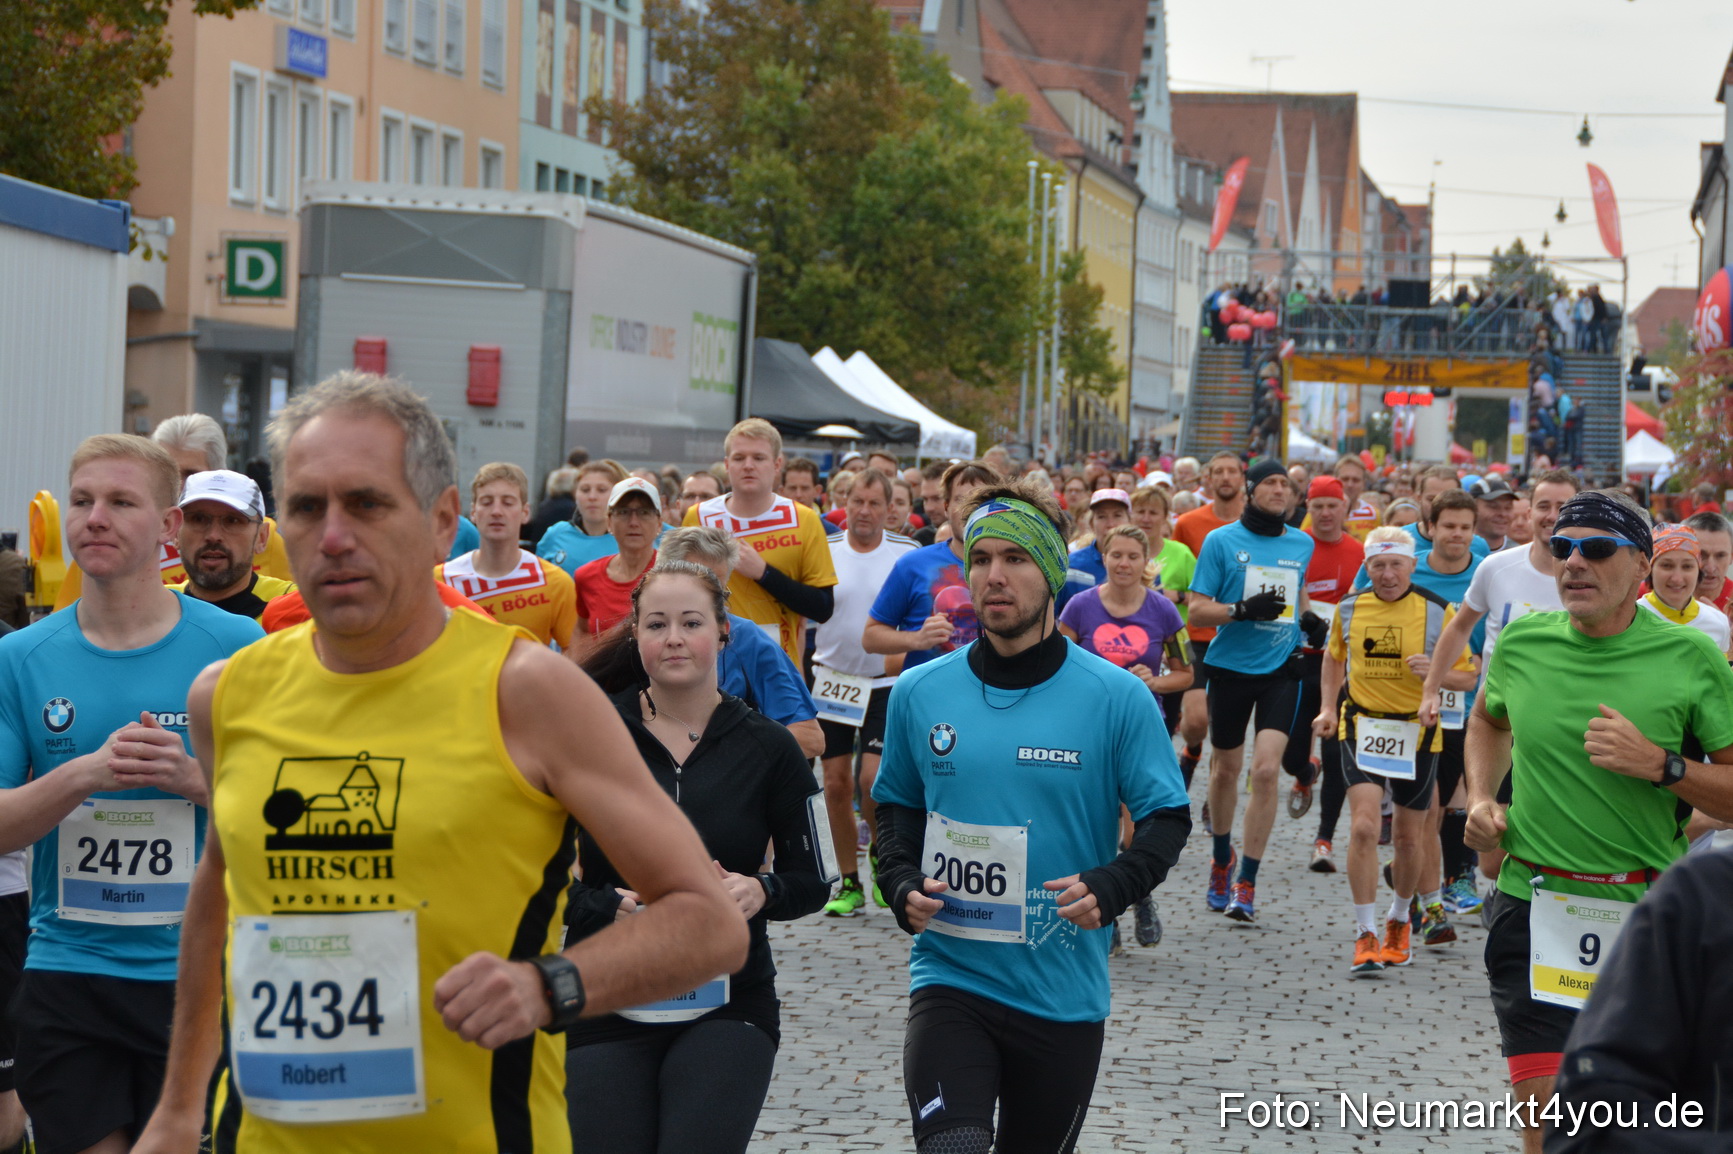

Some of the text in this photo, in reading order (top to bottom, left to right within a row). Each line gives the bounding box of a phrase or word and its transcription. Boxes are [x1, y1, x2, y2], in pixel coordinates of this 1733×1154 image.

[235, 246, 277, 291] D
[616, 318, 648, 355] INDUSTRY
[1383, 361, 1436, 382] ZIEL
[753, 534, 802, 552] BÖGL
[985, 526, 1029, 546] firmenlauf
[1028, 546, 1052, 579] neumarkt
[502, 592, 550, 613] BÖGL
[1100, 645, 1140, 656] adidas
[1364, 659, 1402, 669] HIRSCH
[821, 681, 861, 703] 2472
[45, 737, 76, 748] PARTL
[46, 747, 76, 755] Neumarkt
[1363, 735, 1405, 756] 2921
[932, 761, 955, 770] PARTL
[1017, 746, 1082, 765] BOCK
[107, 811, 154, 823] BOCK
[952, 831, 990, 846] BOCK
[78, 836, 173, 876] 2478
[265, 855, 395, 880] HIRSCH
[932, 851, 1007, 897] 2066
[1583, 874, 1605, 882] balance
[102, 888, 145, 904] Martin
[272, 893, 397, 906] APOTHEKE
[941, 899, 994, 921] Alexander
[1579, 906, 1621, 921] BOCK
[284, 935, 351, 953] BOCK
[1579, 932, 1601, 967] 9
[251, 977, 384, 1041] 2434
[281, 1062, 346, 1085] Robert
